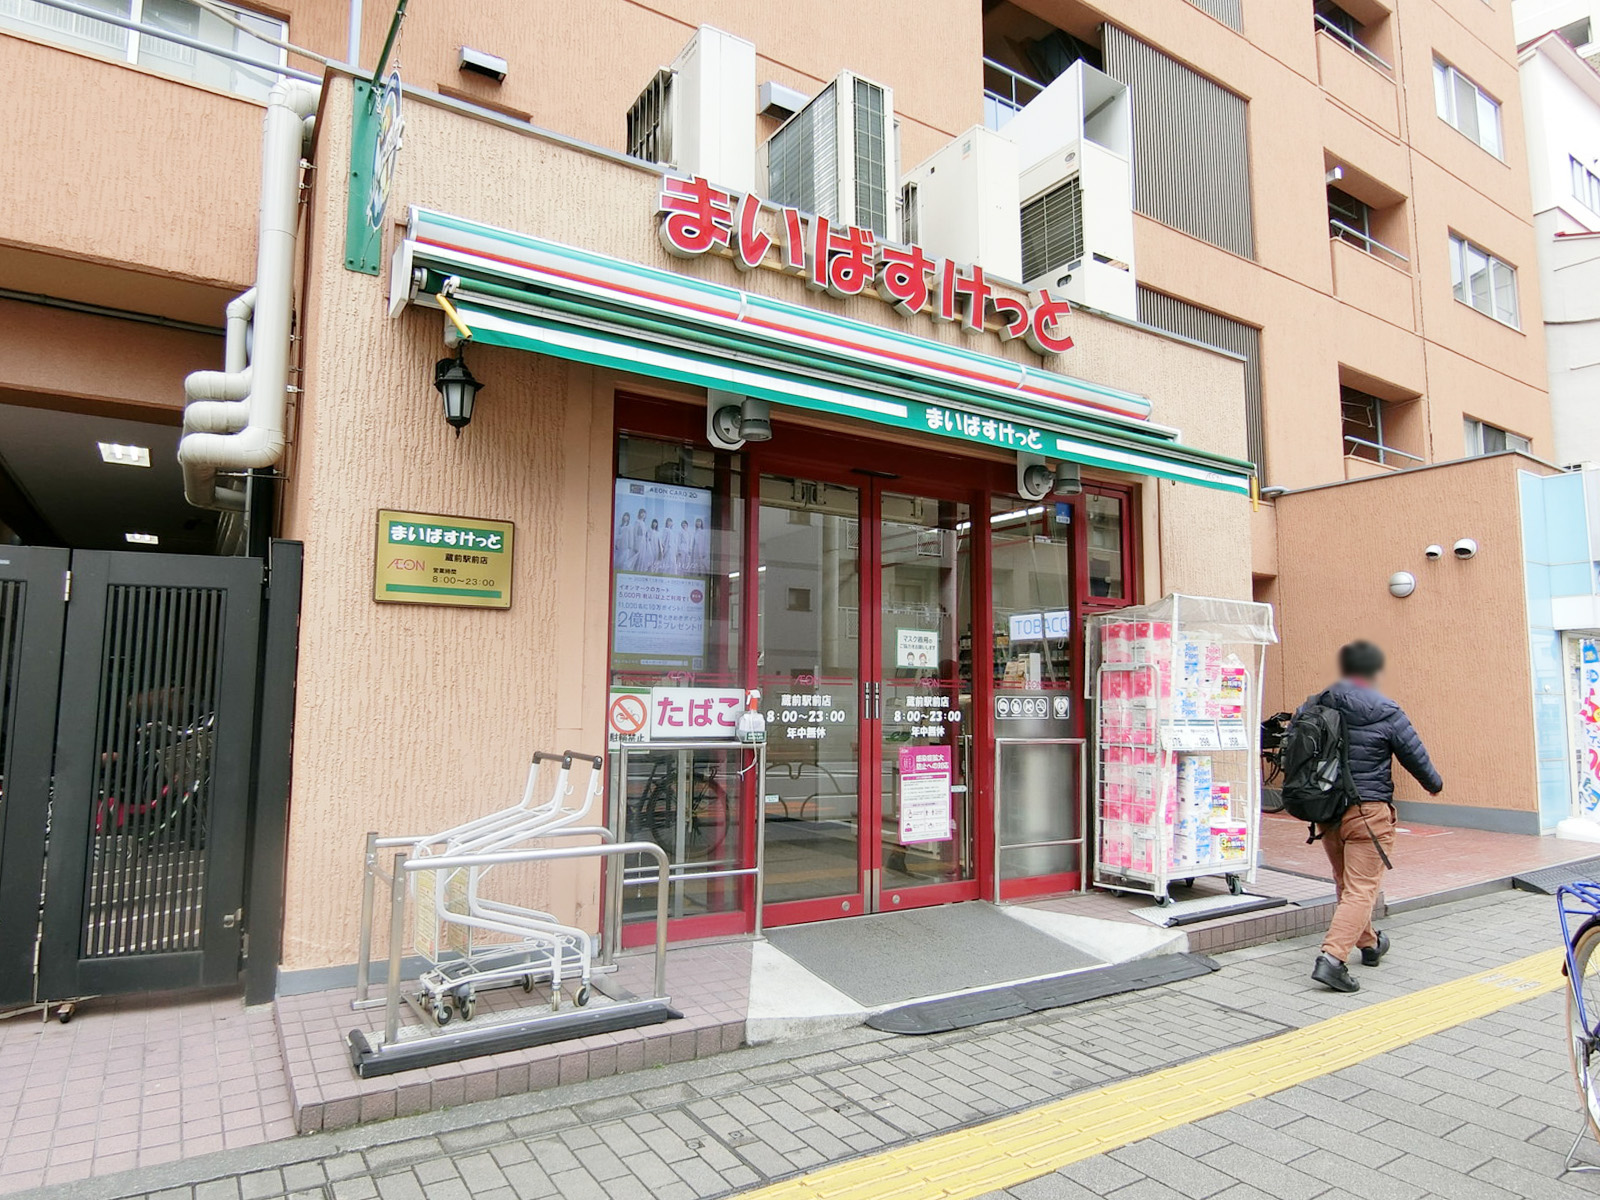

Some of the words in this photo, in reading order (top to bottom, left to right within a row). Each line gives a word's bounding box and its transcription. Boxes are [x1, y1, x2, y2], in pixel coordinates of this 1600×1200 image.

[657, 174, 1076, 356] まいばすけっと
[925, 406, 1043, 450] まいばすけっと
[390, 525, 502, 549] まいばすけっと
[444, 552, 488, 565] 蔵前駅前店
[780, 694, 832, 707] 蔵前駅前店
[905, 696, 950, 708] 蔵前駅前店
[657, 697, 740, 727] たばこ
[786, 727, 827, 740] 年中無休
[910, 725, 946, 738] 年中無休
